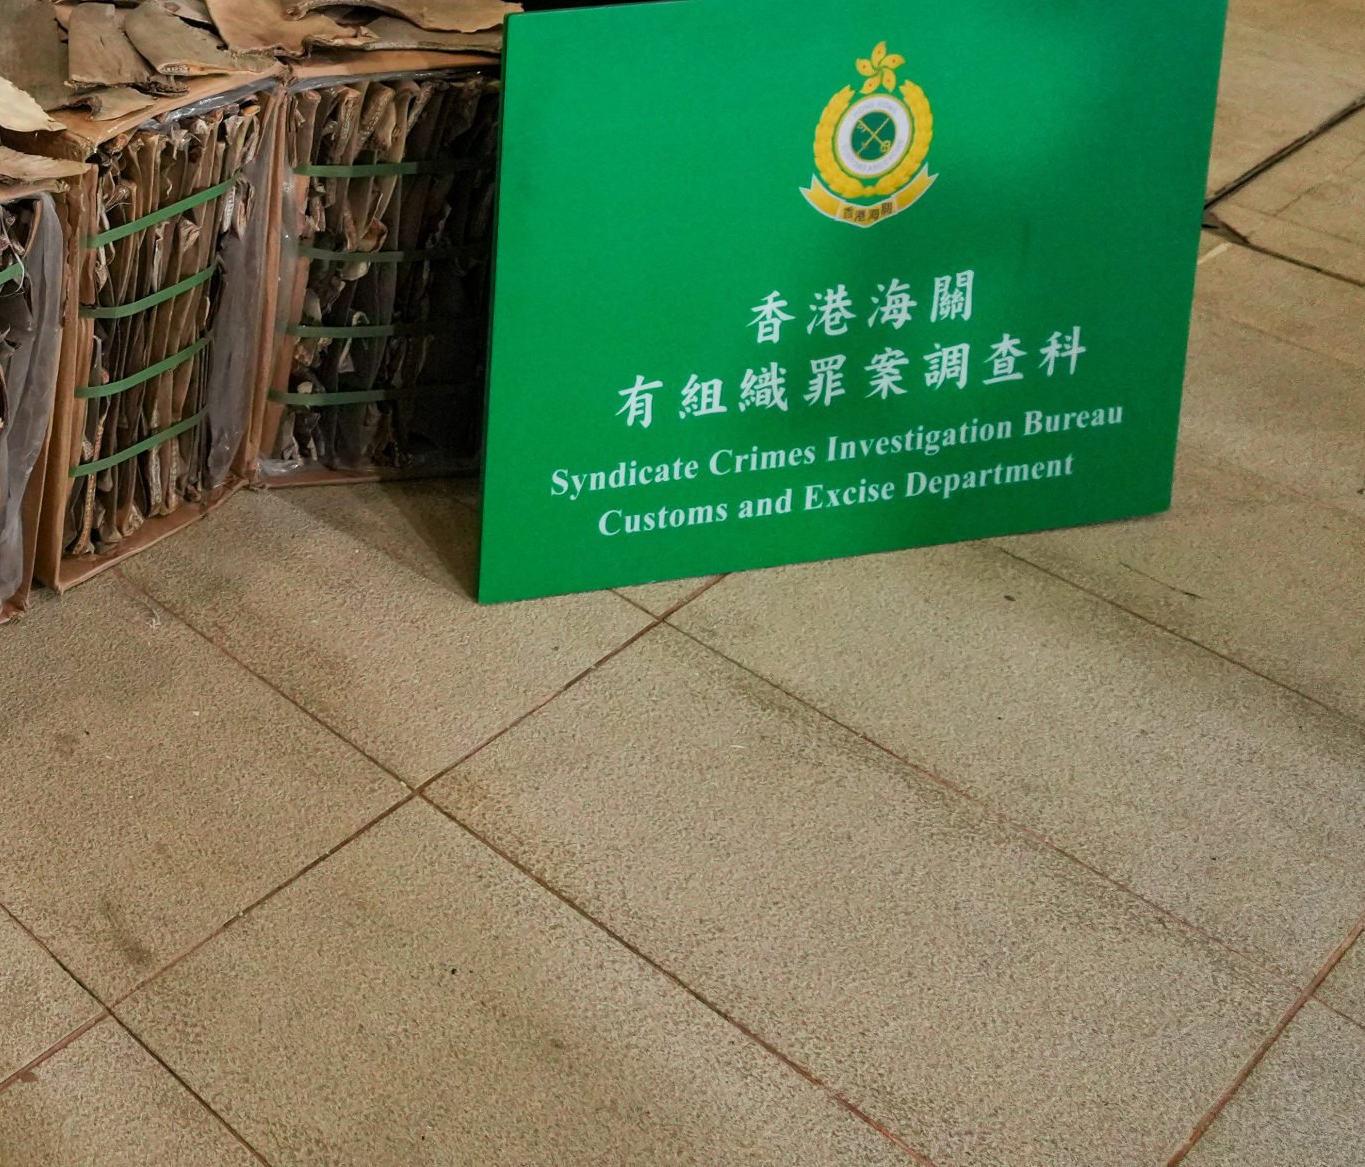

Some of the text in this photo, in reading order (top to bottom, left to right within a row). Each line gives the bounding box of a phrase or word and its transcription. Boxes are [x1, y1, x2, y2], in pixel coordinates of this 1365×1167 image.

[745, 269, 975, 345] 香港海關
[614, 325, 1087, 429] 有組織罪案調查科
[550, 405, 1124, 501] Syndicate Crimes Investigation Bureau
[598, 453, 1076, 537] Customs and Excise Department
